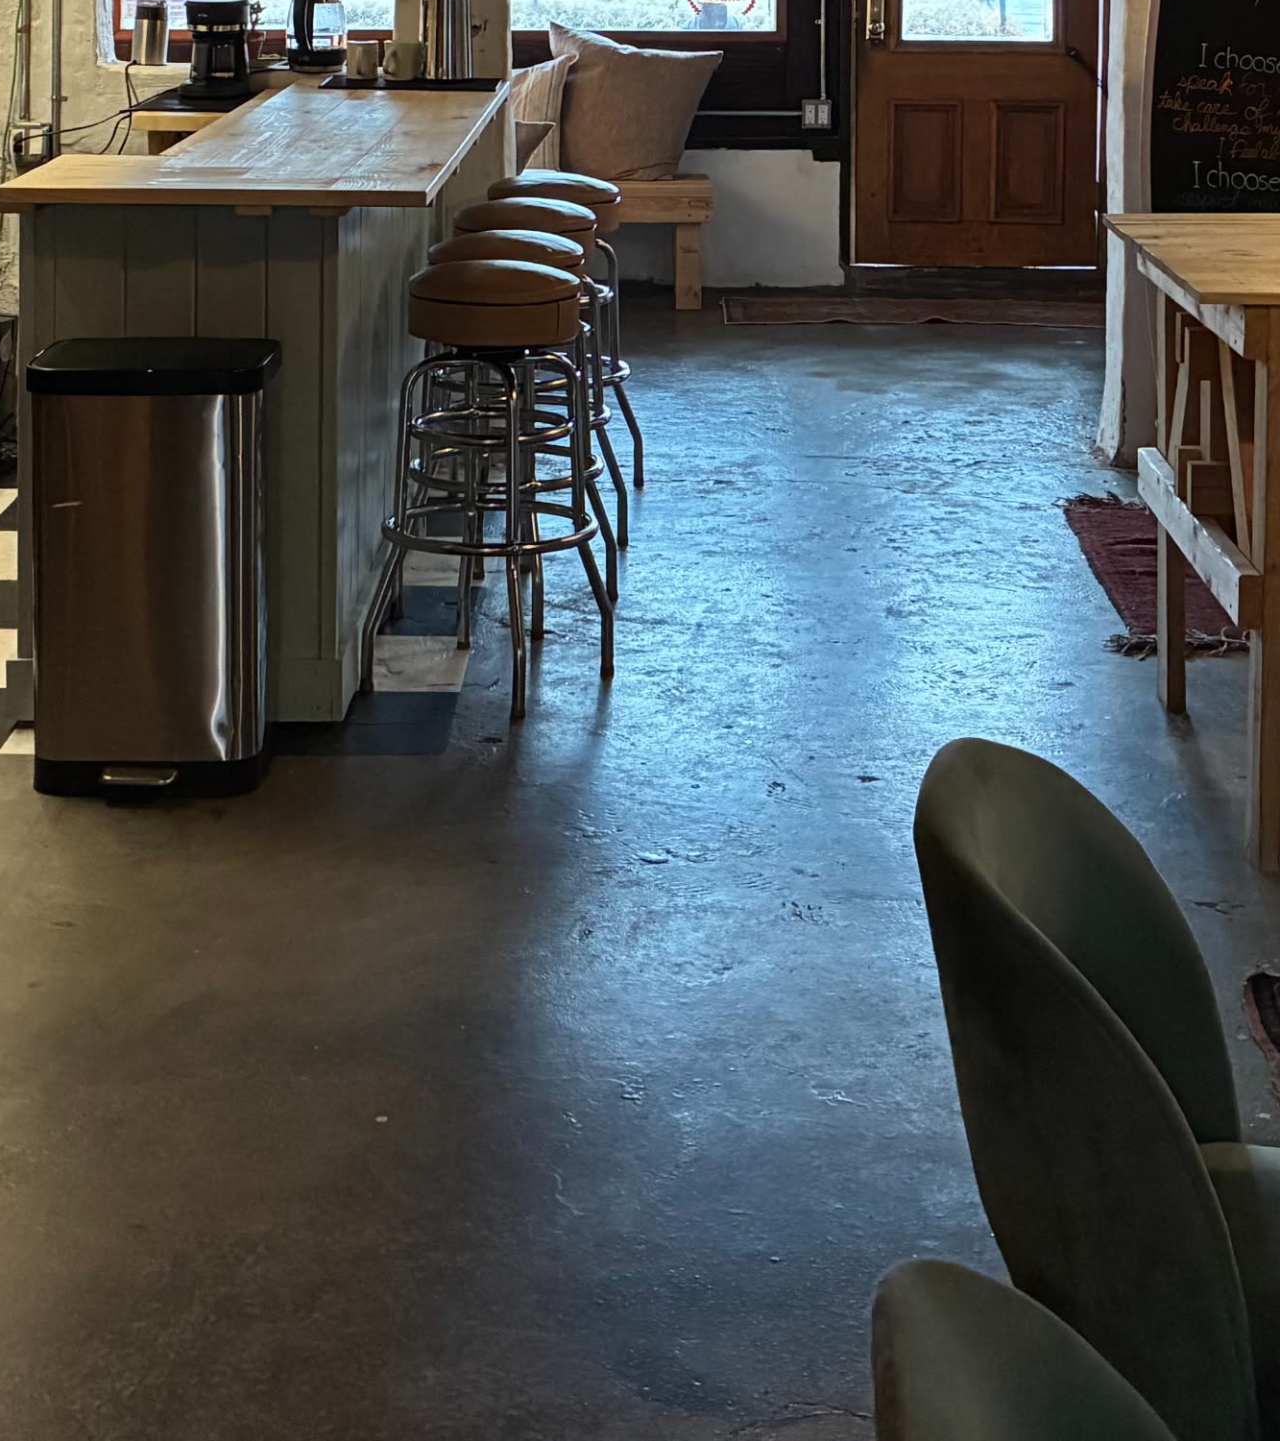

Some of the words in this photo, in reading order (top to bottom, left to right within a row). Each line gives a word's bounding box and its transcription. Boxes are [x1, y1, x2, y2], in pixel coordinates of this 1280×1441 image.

[1199, 43, 1208, 68] I
[1177, 71, 1233, 96] speak
[1244, 99, 1272, 124] of
[1193, 160, 1201, 189] I
[1206, 160, 1280, 192] choose
